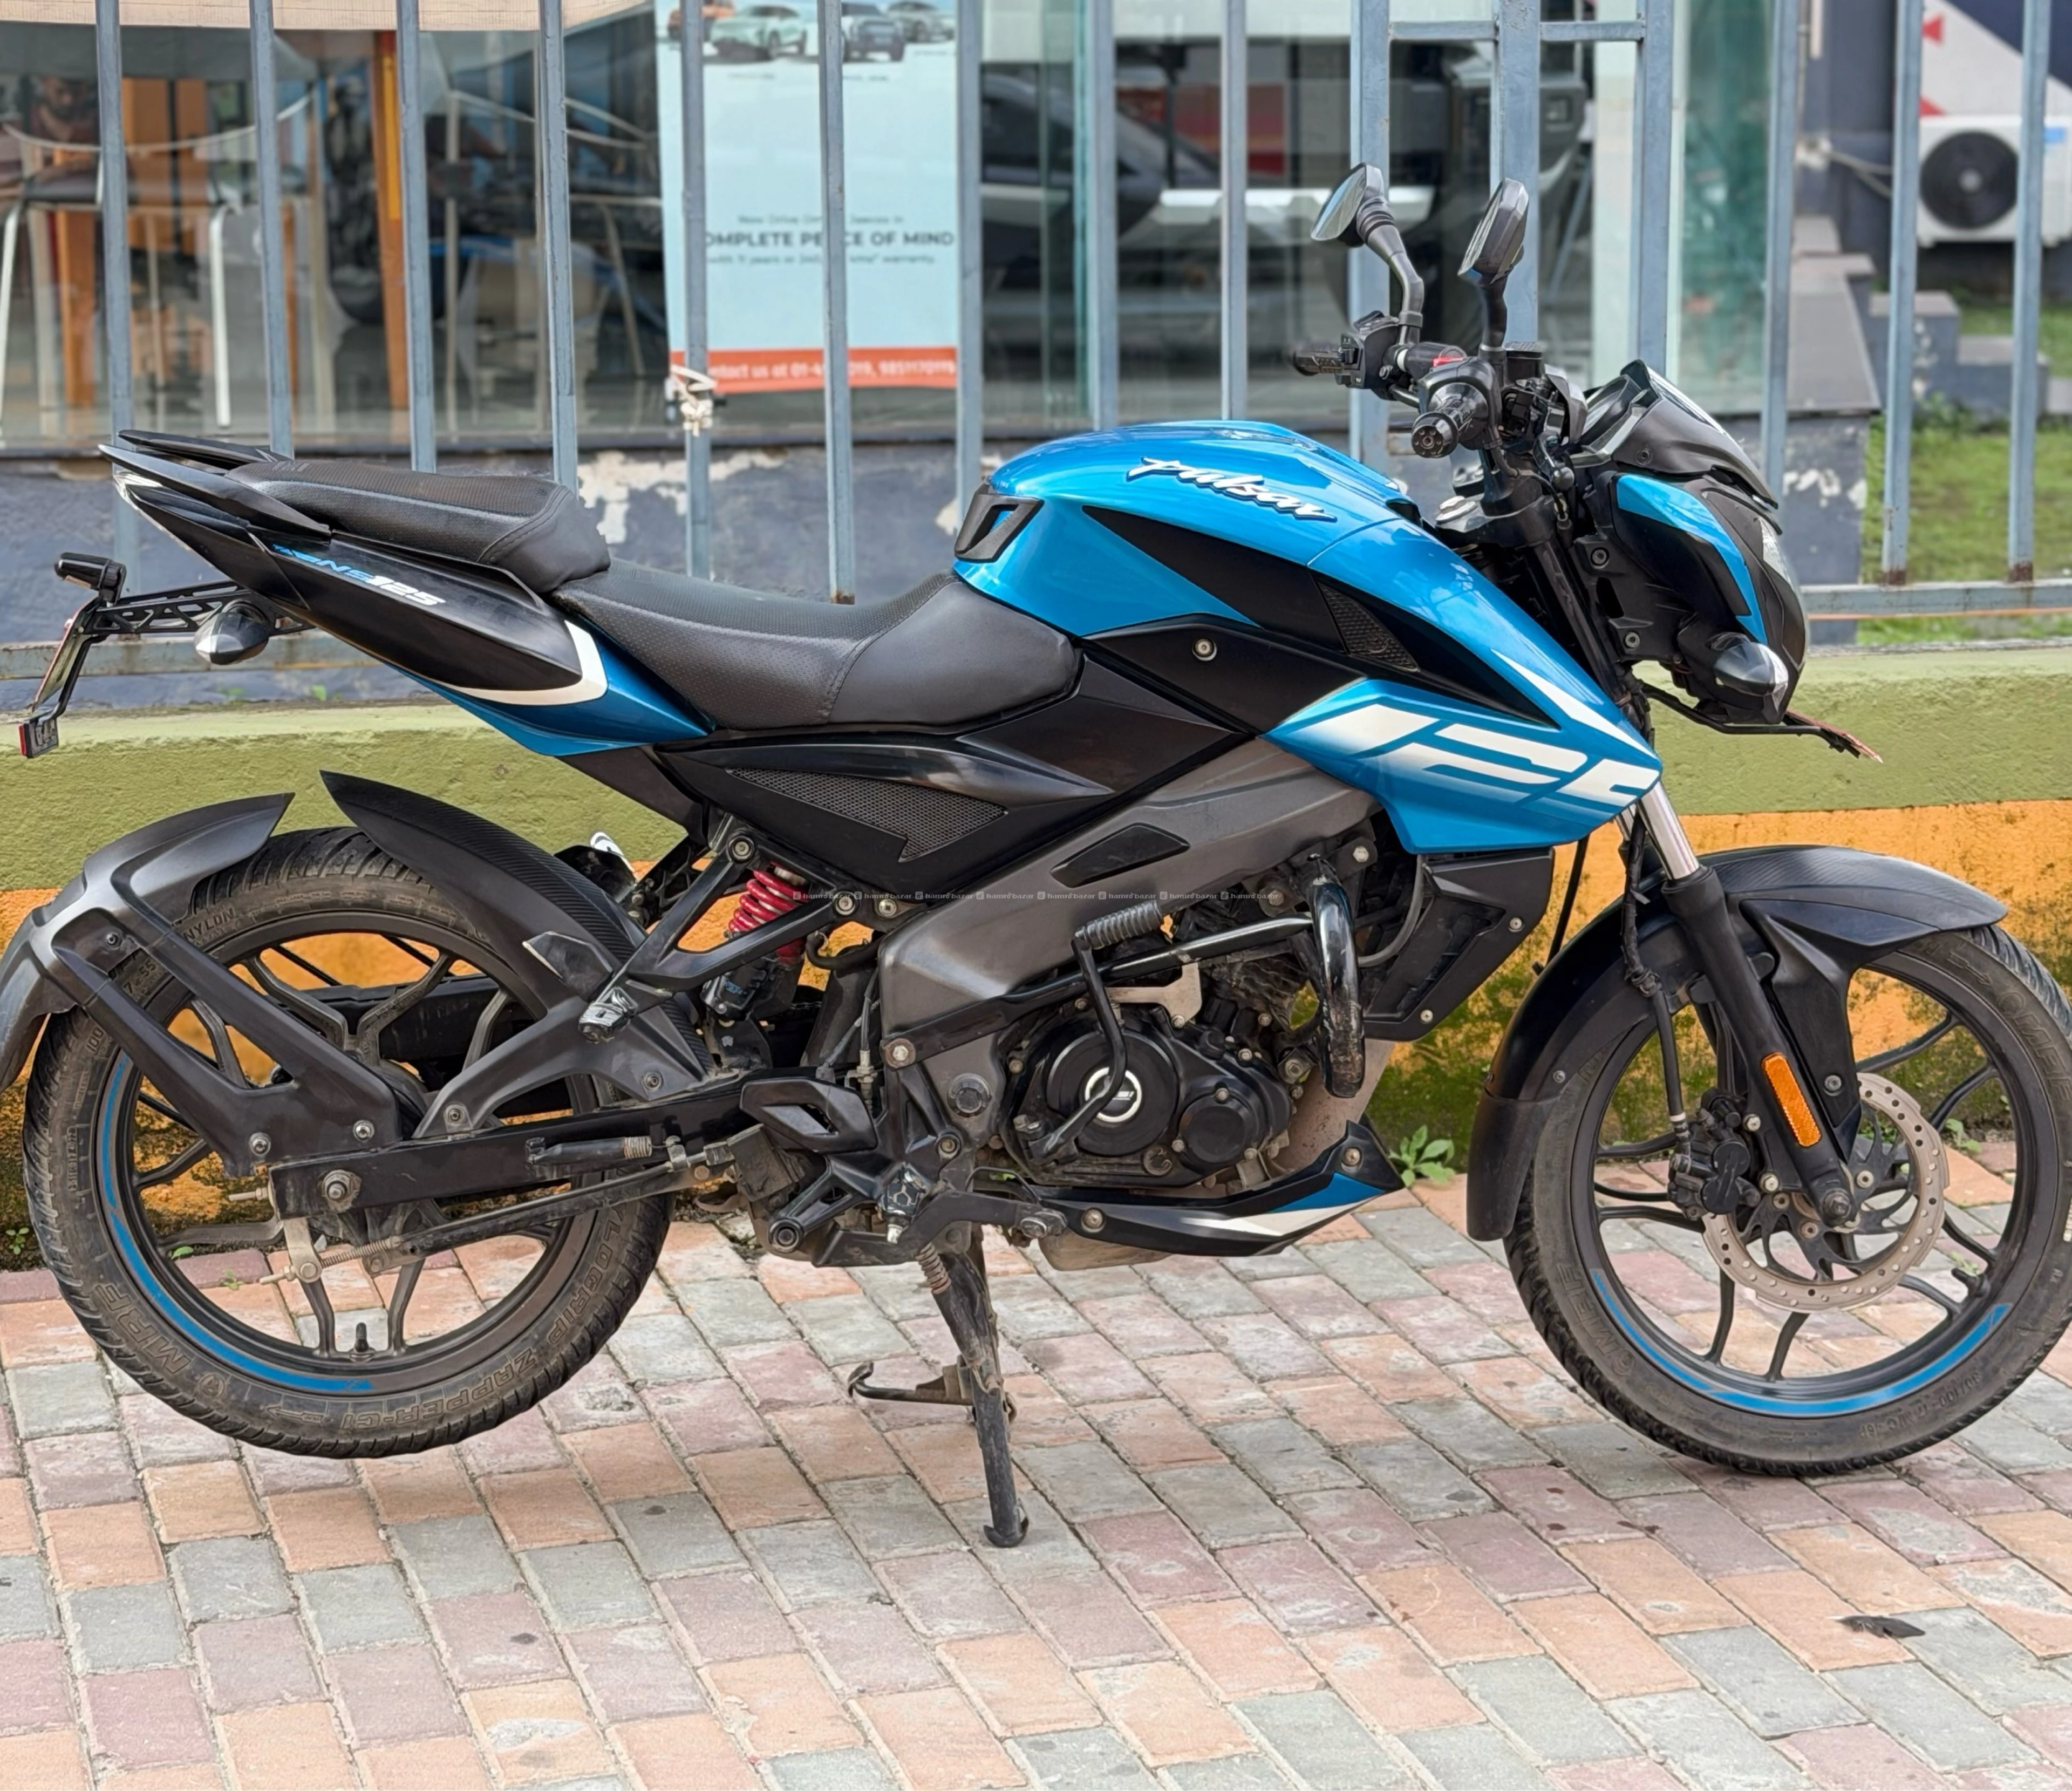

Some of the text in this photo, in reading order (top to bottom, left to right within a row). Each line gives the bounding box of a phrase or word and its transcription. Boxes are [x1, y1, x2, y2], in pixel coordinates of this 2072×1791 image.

[706, 231, 954, 247] OMPLETE PECE OF MIND
[1127, 457, 1338, 522] Pulsar
[545, 1193, 632, 1346] YLOGRIP
[93, 1282, 191, 1375] MRF
